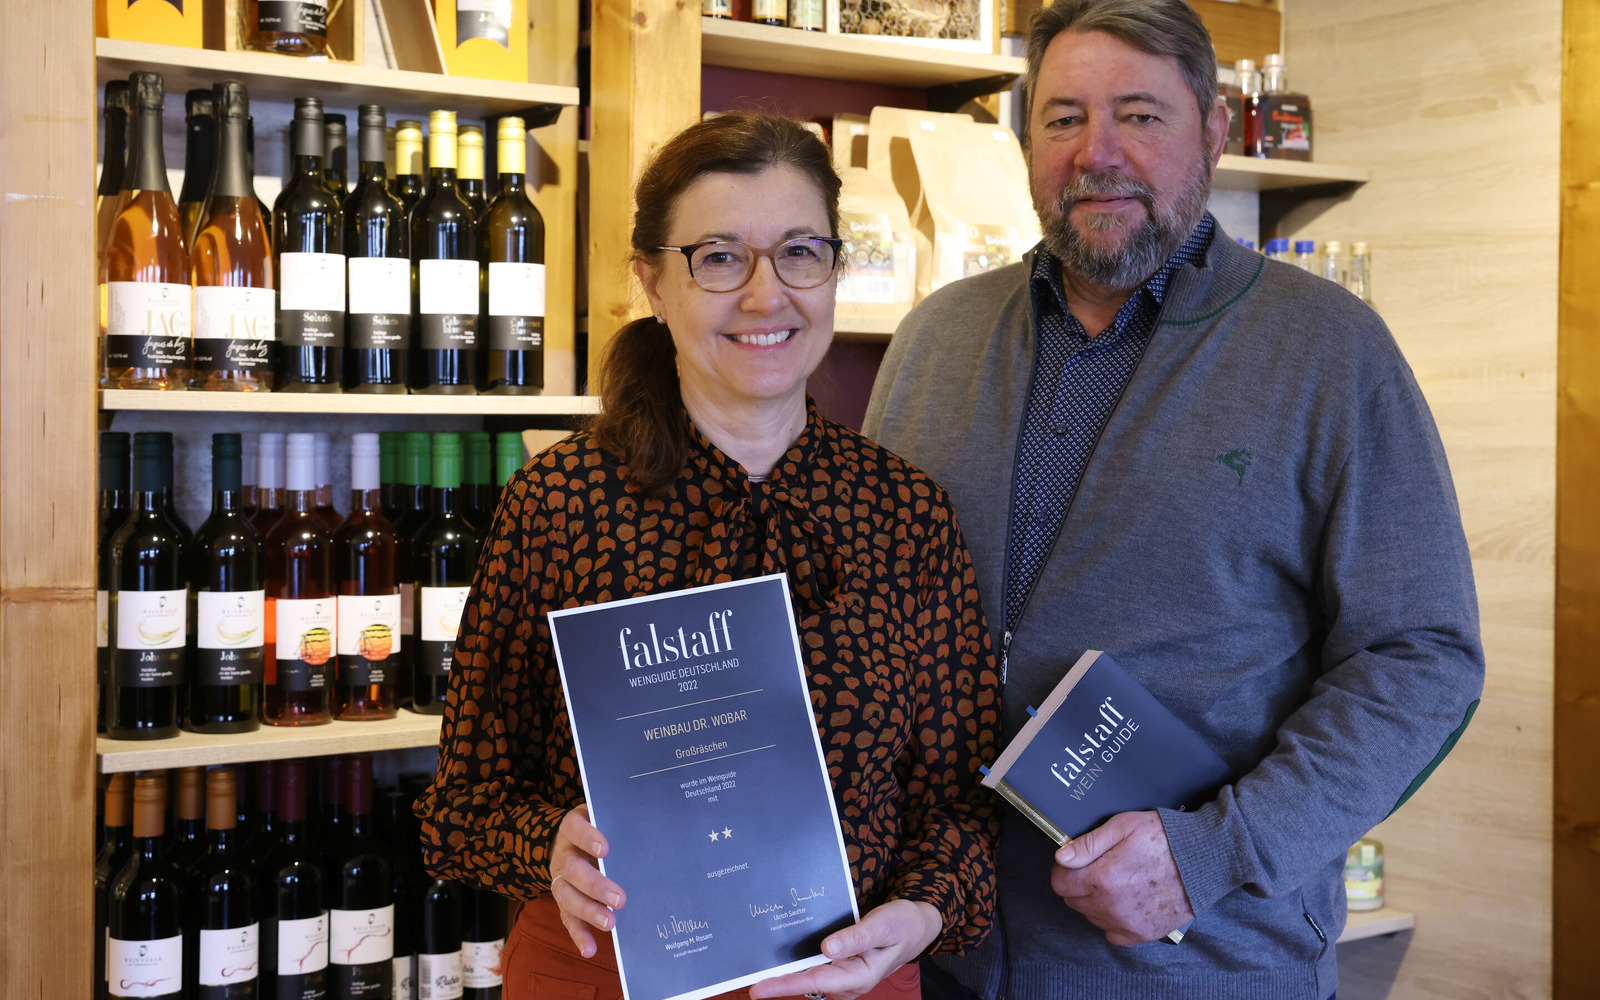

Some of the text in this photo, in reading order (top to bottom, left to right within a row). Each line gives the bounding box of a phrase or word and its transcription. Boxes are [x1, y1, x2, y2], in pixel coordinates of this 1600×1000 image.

[618, 609, 734, 671] falstaff
[629, 658, 740, 688] WEINGUIDE DEUTSCHLAND
[678, 680, 698, 692] 2022
[643, 709, 748, 741] WEINBAU DR. WOBAR
[675, 741, 728, 759] Großräschen
[1050, 696, 1125, 788] falstaff
[1069, 718, 1140, 801] WEIN GUIDE
[680, 770, 737, 789] wurde im Weinguide
[685, 780, 736, 799] Deutschland 2022
[707, 794, 718, 803] mit
[773, 907, 806, 921] Ulrich Sautter
[664, 939, 689, 951] Wolfgang
[695, 933, 713, 943] Rosam
